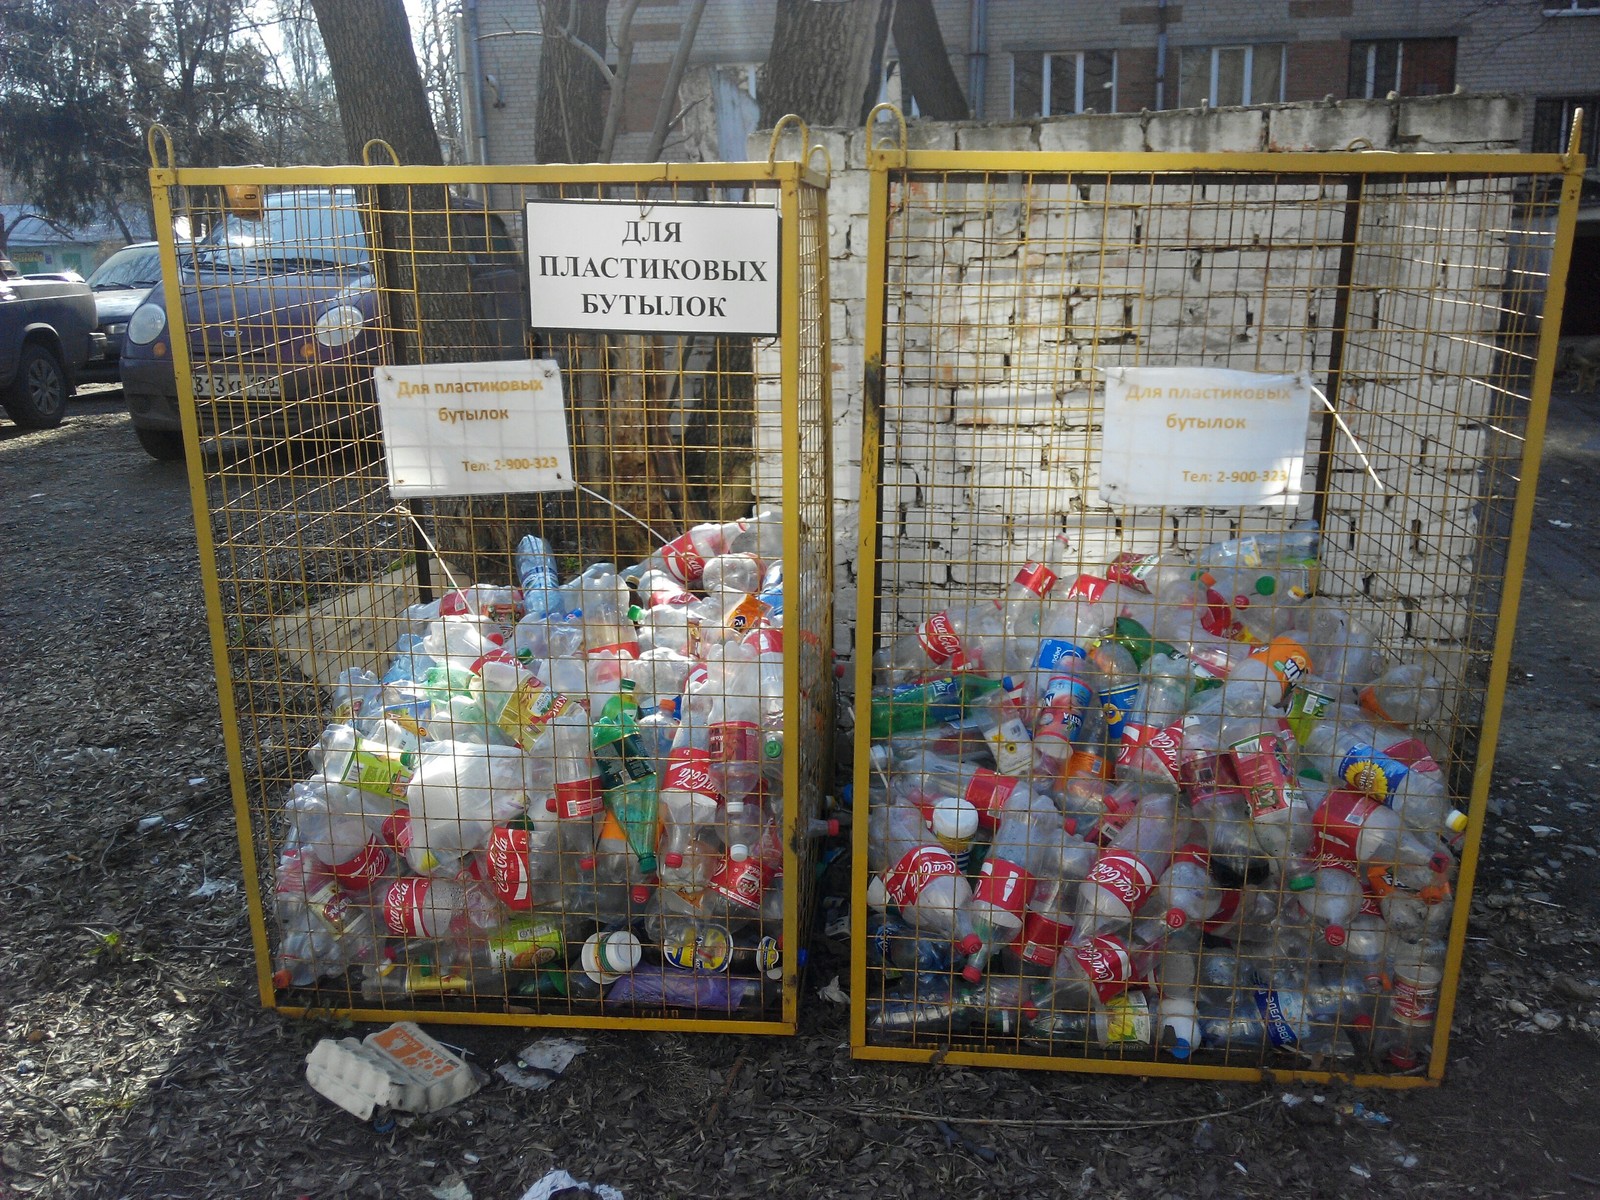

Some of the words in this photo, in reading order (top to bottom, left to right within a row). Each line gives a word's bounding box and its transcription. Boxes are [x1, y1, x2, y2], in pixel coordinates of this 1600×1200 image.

[622, 220, 682, 246] ДЛЯ
[539, 255, 767, 282] ПЛАСТИКОВЫХ
[581, 293, 727, 317] БУТЫЛОК
[397, 381, 430, 398] Для
[434, 379, 544, 395] пластиковых
[1125, 385, 1163, 401] Для
[1168, 386, 1291, 401] пластиковых
[438, 407, 510, 424] бутылок
[1166, 413, 1247, 431] бутылок
[462, 460, 490, 471] Тел:
[494, 457, 559, 471] 2-900-323
[1182, 470, 1213, 482] Тел:
[1217, 470, 1288, 483] 2-900-323
[1086, 863, 1141, 902] Coca-Cola
[387, 881, 410, 934] Coca-Cola
